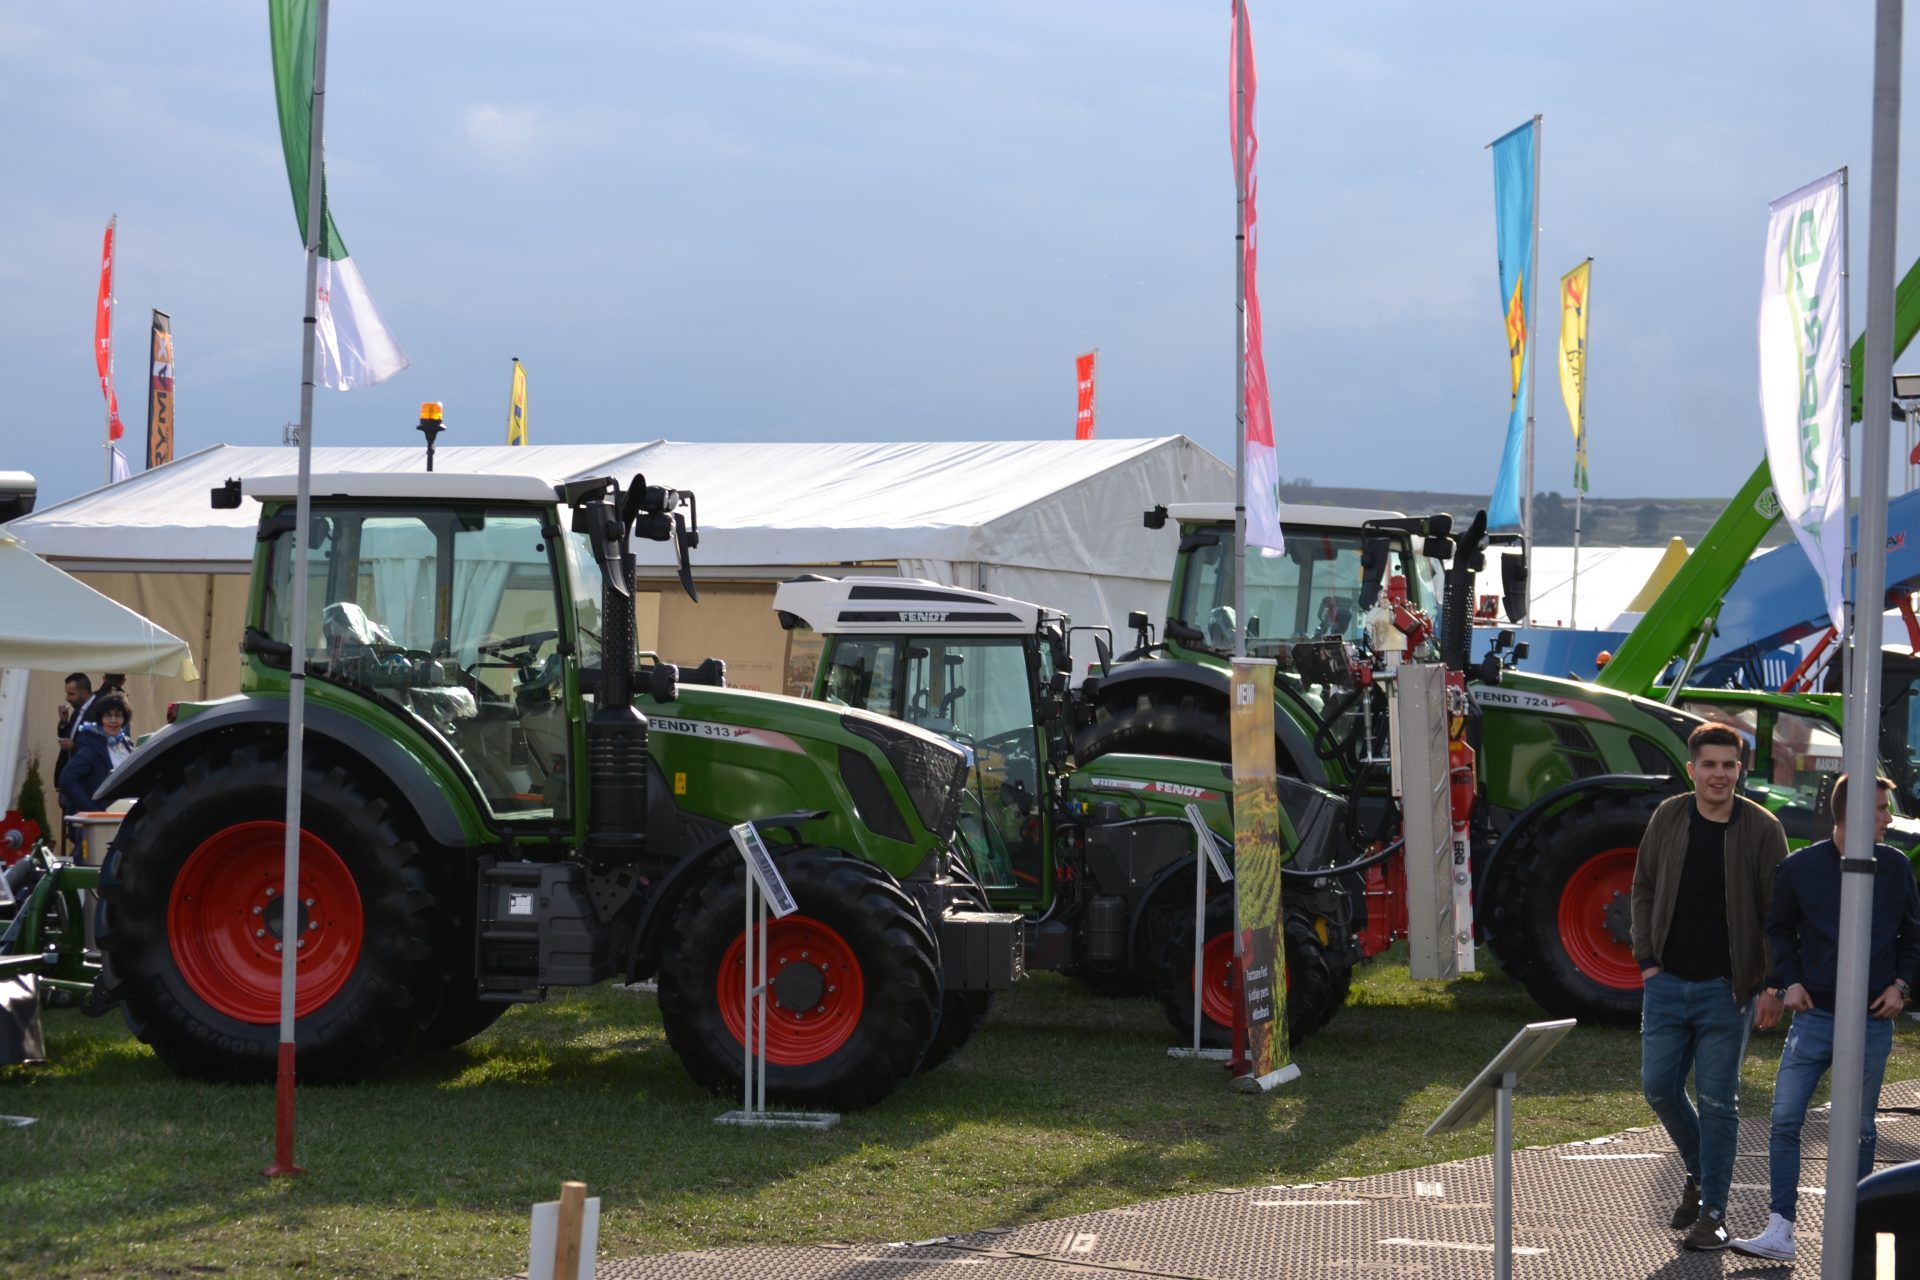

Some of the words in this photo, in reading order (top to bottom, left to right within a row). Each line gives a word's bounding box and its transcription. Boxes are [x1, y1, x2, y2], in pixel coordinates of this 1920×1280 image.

[899, 611, 950, 622] FENDT
[1474, 691, 1519, 704] FENDT
[1523, 696, 1549, 707] 724
[649, 718, 698, 733] FENDT
[704, 725, 731, 737] 313
[1155, 781, 1205, 797] FENDT
[1454, 841, 1466, 866] ERO
